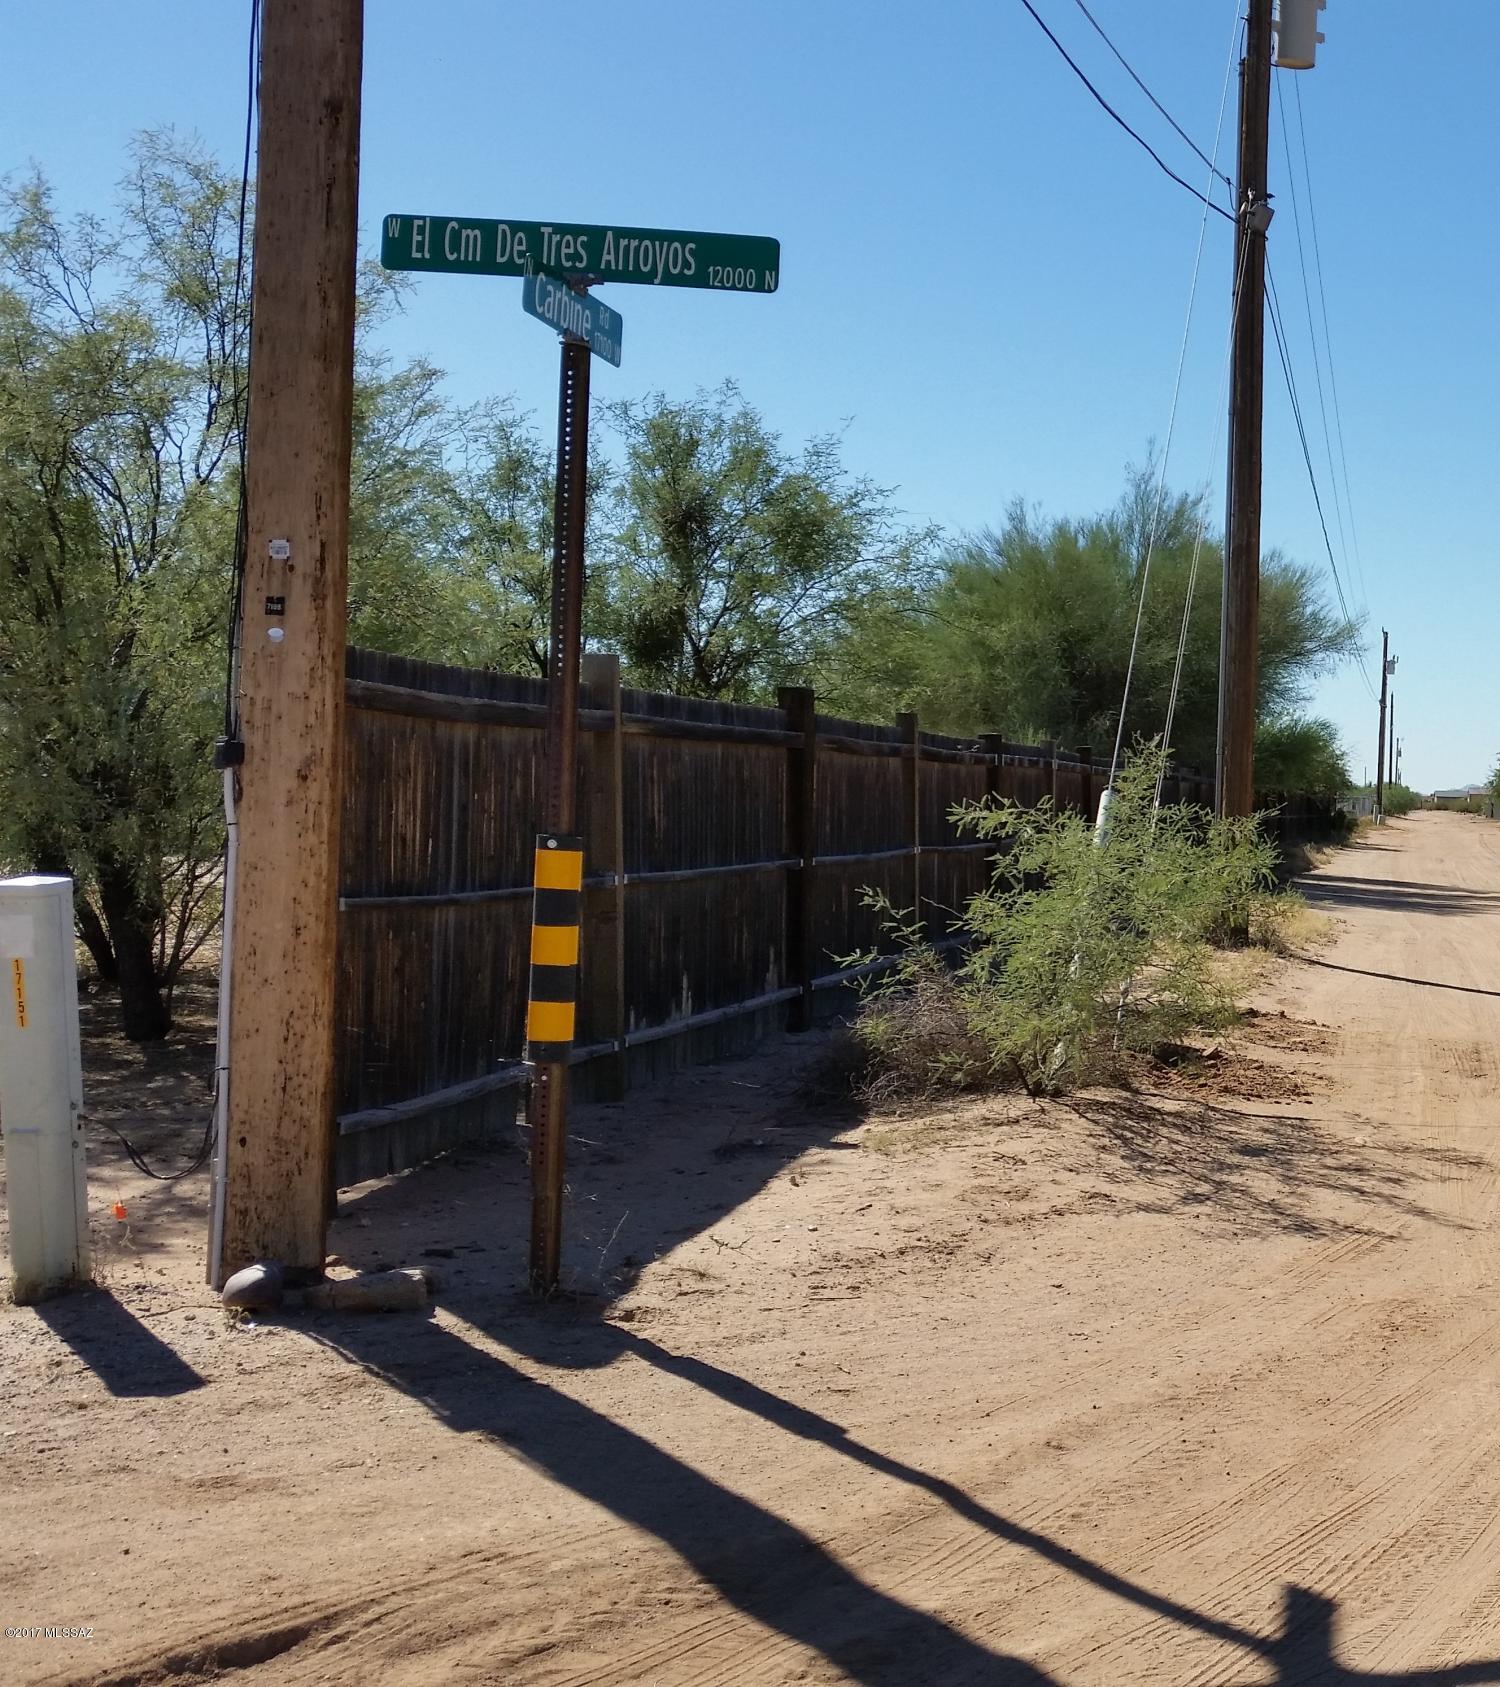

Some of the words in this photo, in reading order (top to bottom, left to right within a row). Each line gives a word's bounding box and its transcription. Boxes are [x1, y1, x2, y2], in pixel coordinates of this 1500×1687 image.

[387, 217, 400, 238] W
[411, 217, 430, 259] El
[444, 220, 481, 262] Cm
[496, 223, 527, 264] De
[540, 226, 588, 268] Tres
[600, 230, 696, 285] Arroyos
[708, 265, 756, 289] 12000
[765, 270, 776, 290] N
[535, 271, 592, 341] Carbine
